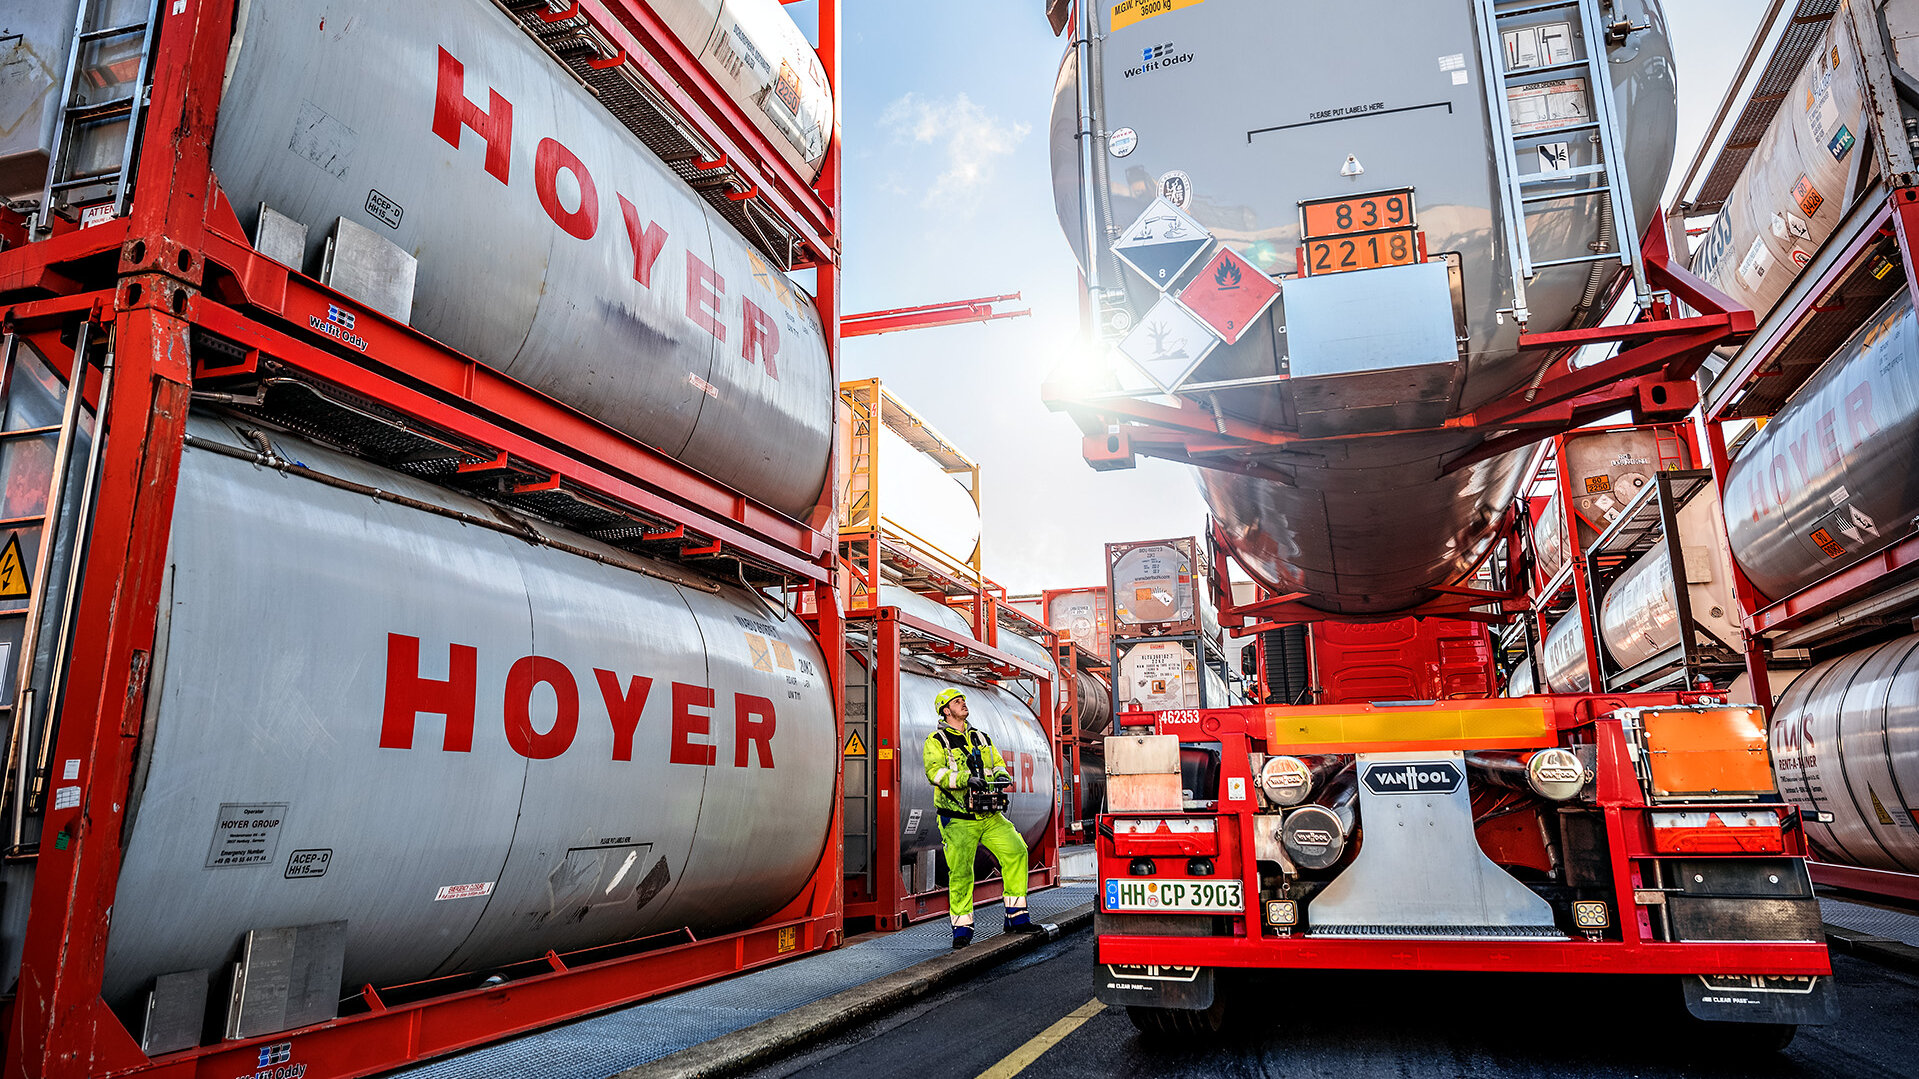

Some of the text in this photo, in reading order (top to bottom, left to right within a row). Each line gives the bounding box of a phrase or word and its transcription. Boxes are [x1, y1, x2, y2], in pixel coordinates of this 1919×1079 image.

[1141, 0, 1171, 16] 36000 kg
[1124, 53, 1194, 78] Welfit Oddy
[778, 81, 798, 110] 2250
[1310, 101, 1385, 119] PLEASE PUT LABELS HERE
[1832, 131, 1851, 156] MTK
[1798, 182, 1806, 198] 60
[432, 44, 780, 382] HOYER
[1335, 197, 1404, 230] 839
[1803, 191, 1821, 215] 3428
[1314, 233, 1408, 270] 2218
[1158, 268, 1166, 278] 8
[309, 315, 368, 352] Welfit Oddy
[1226, 320, 1234, 330] 3
[1747, 381, 1880, 523] HOYER
[1549, 628, 1576, 671] HOYER
[379, 632, 776, 769] HOYER
[1160, 710, 1200, 724] 462353
[1775, 713, 1816, 753] TWS
[221, 820, 280, 829] HOYER GROUP
[1121, 884, 1240, 907] HH CP 3903
[275, 1063, 307, 1079] Oddy
